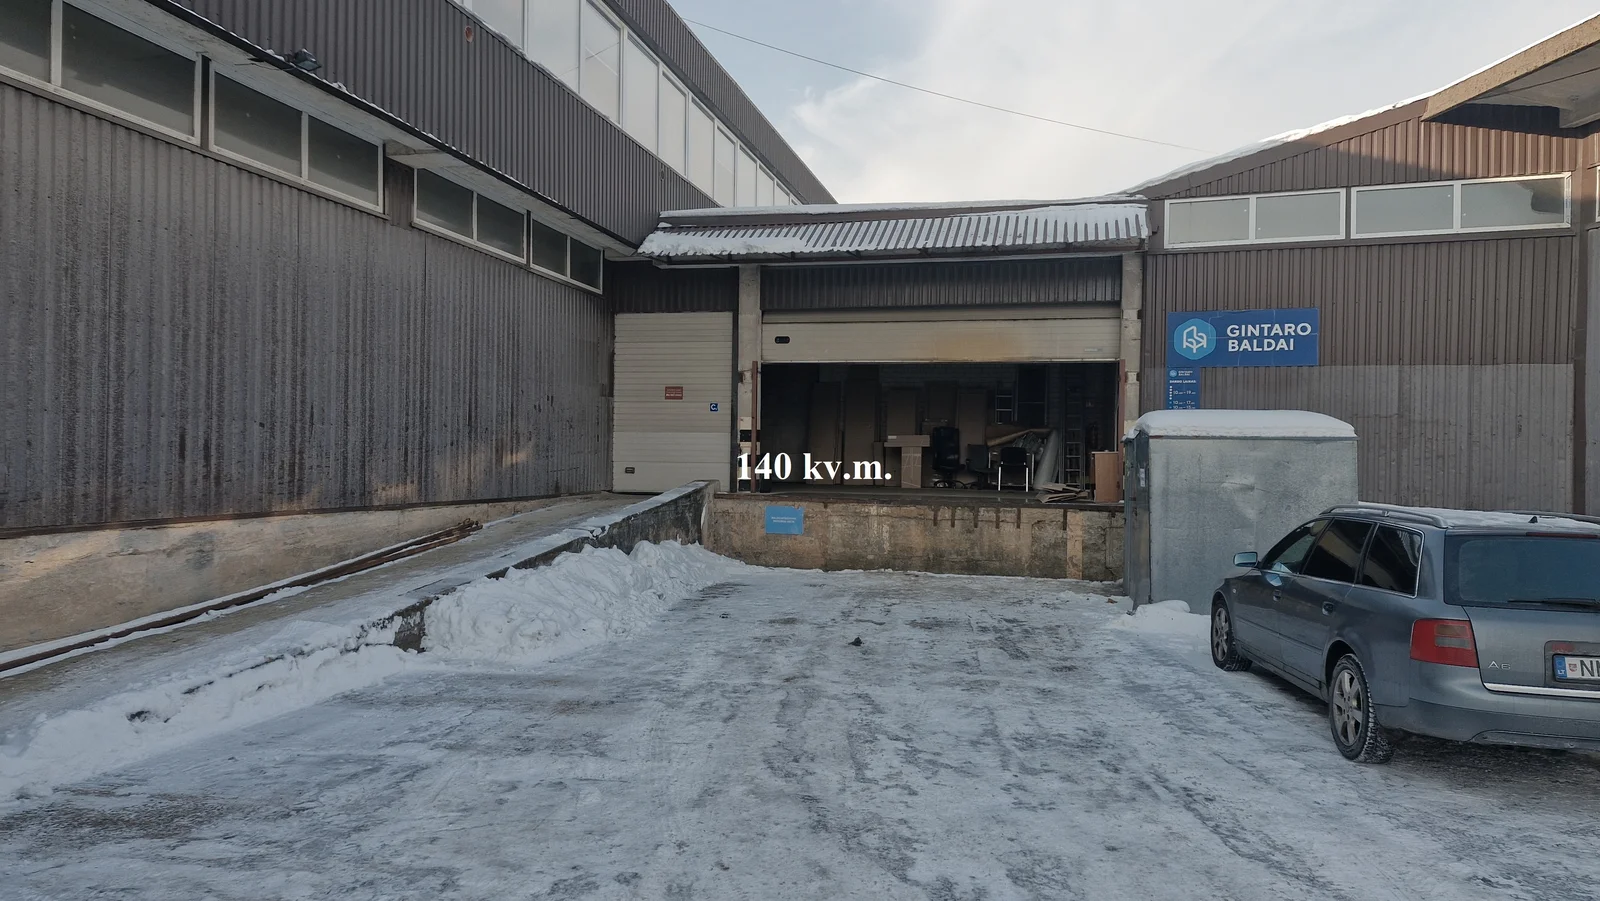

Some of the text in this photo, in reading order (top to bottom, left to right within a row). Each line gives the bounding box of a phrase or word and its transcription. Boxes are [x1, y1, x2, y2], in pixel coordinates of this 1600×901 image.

[1226, 322, 1312, 338] GINTARO
[1228, 338, 1294, 352] BALDAI
[1488, 660, 1511, 670] A6
